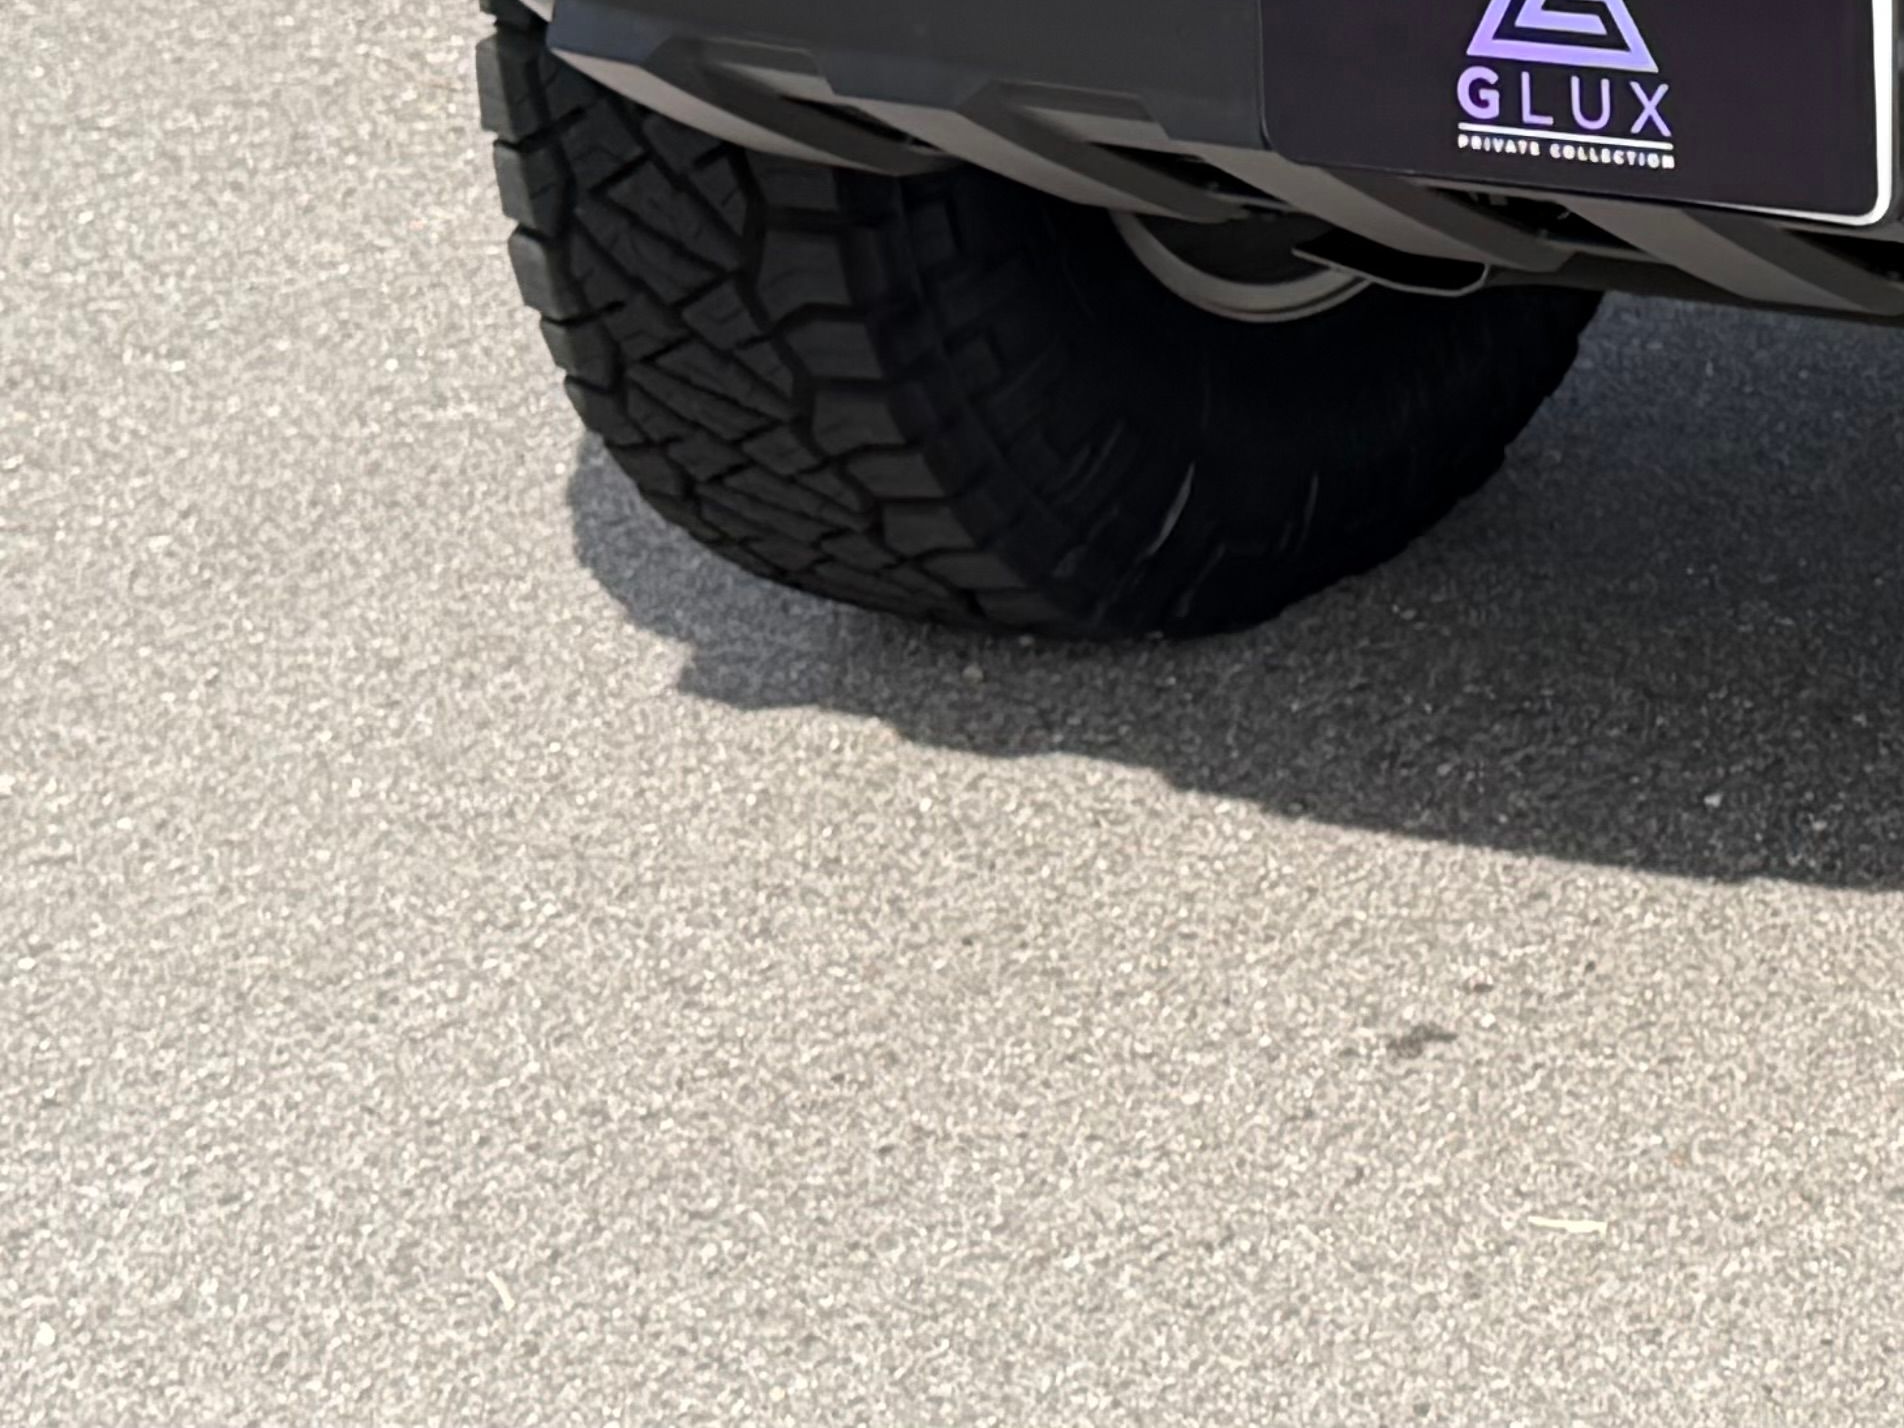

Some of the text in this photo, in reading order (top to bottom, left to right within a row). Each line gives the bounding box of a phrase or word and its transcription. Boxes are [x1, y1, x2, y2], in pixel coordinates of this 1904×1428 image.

[1456, 65, 1672, 137] GLUX
[1457, 133, 1676, 170] PRIVATE COLLECTION
